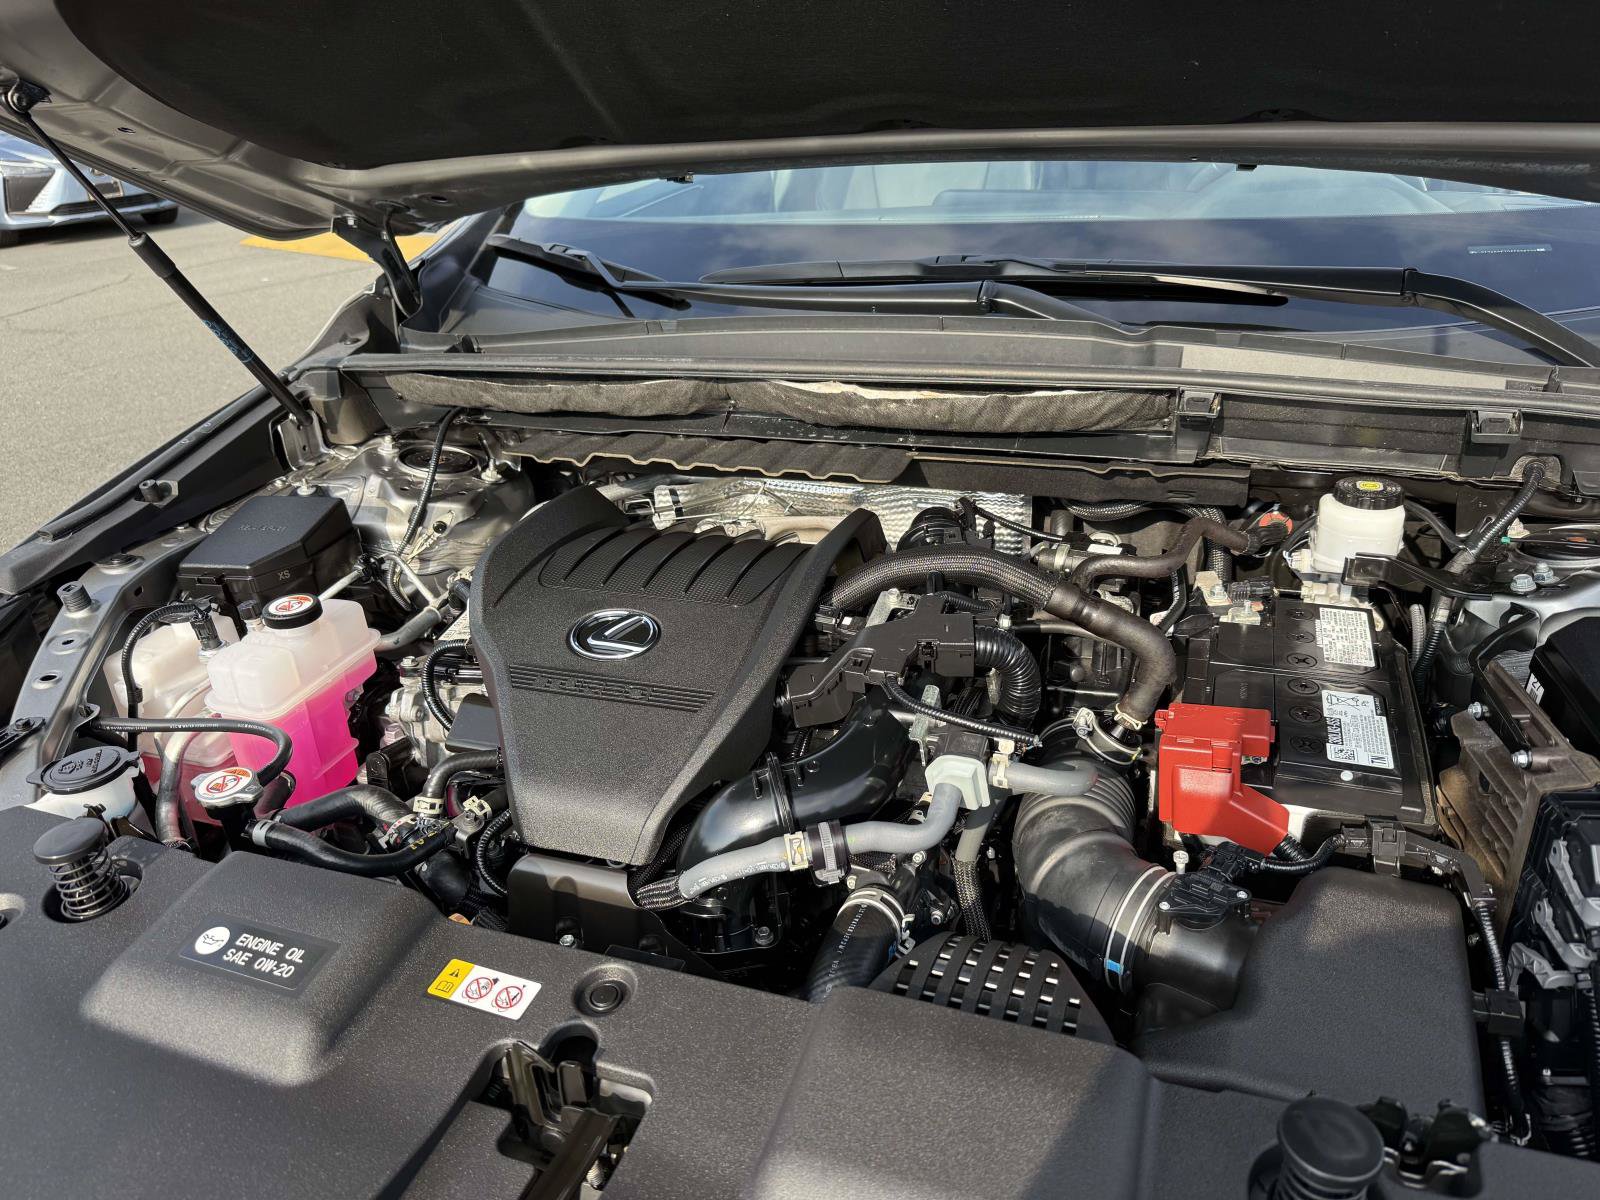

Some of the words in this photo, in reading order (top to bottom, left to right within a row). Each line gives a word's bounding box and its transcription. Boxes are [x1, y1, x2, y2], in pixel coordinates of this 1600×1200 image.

[278, 569, 291, 581] XS
[236, 934, 284, 955] ENGINE
[286, 948, 305, 963] OIL
[223, 949, 252, 965] SAE
[255, 958, 294, 977] 0W-20
